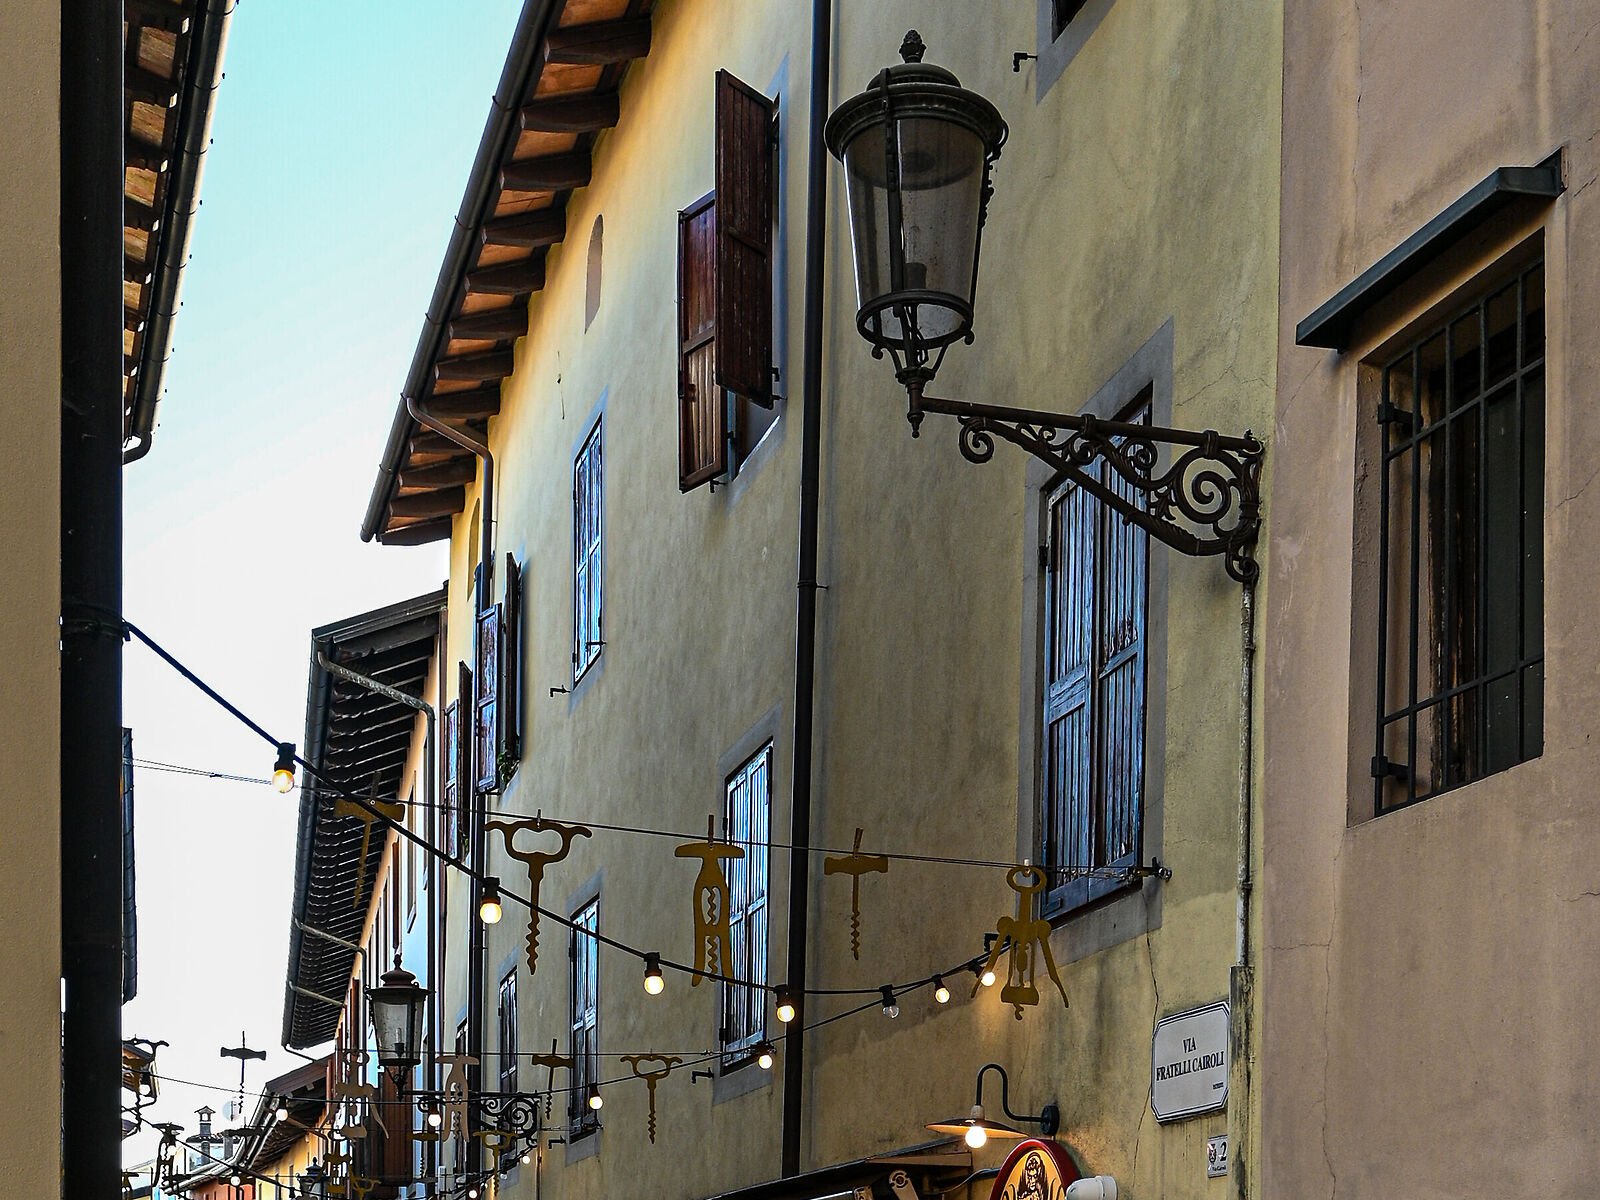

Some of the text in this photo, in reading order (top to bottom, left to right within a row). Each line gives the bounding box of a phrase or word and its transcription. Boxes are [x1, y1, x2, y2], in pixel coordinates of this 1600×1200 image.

[1183, 1036, 1197, 1054] VIA
[1156, 1051, 1224, 1081] FRATELLI CAIROLI
